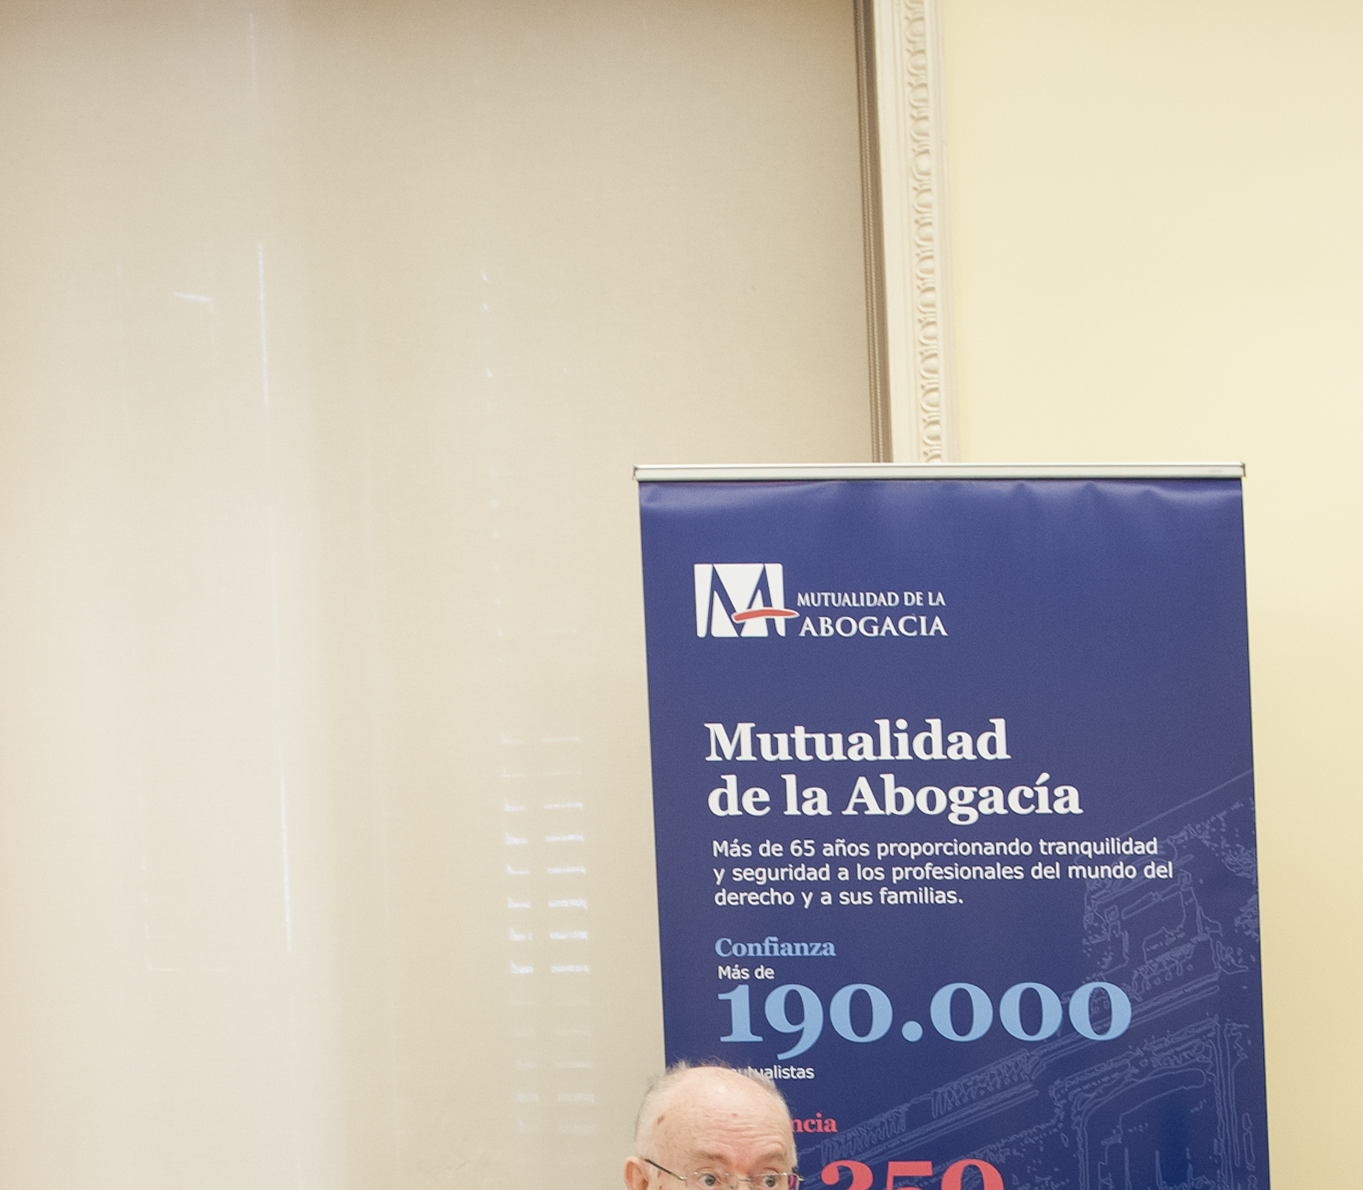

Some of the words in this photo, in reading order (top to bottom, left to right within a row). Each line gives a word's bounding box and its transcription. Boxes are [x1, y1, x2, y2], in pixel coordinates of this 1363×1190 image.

[797, 591, 899, 607] MUTUALIDAD
[904, 591, 923, 607] DE
[928, 591, 947, 606] LA
[799, 615, 949, 638] ABOGACIA
[703, 718, 1011, 761] Mutualidad
[708, 774, 771, 816] de
[781, 773, 832, 816] la
[841, 772, 1084, 826] Abogacía
[712, 838, 753, 857] Más
[758, 839, 784, 857] de
[790, 839, 815, 857] 65
[822, 838, 870, 857] años
[876, 838, 1033, 861] proporcionando
[1039, 837, 1158, 859] tranquilidad
[712, 867, 726, 886] y
[732, 863, 830, 885] seguridad
[837, 867, 849, 880] a
[856, 863, 885, 881] los
[892, 862, 1024, 884] profesionales
[1031, 861, 1061, 880] del
[1068, 861, 1137, 879] mundo
[1143, 861, 1174, 879] del
[714, 887, 795, 906] derecho
[801, 891, 814, 909] y
[820, 891, 832, 905] a
[839, 890, 874, 905] sus
[879, 887, 964, 905] familias.
[714, 936, 837, 957] Confianza
[717, 964, 750, 980] Más
[754, 964, 775, 980] de
[717, 982, 1133, 1060] 190.000
